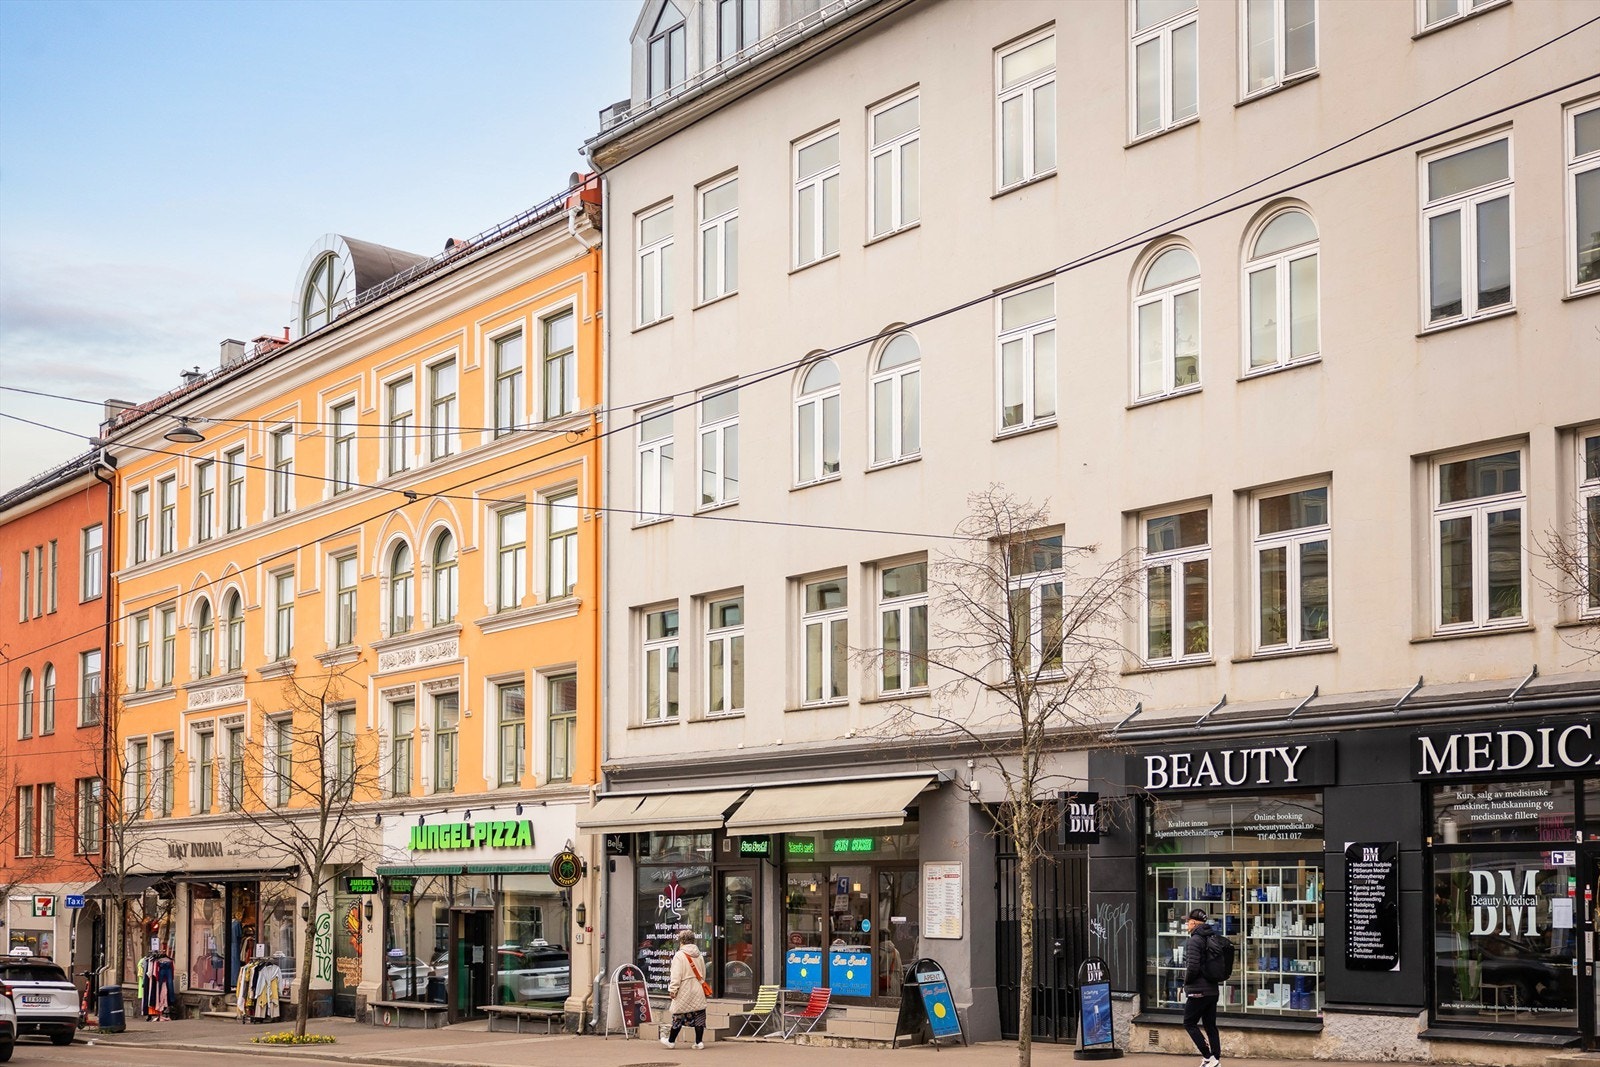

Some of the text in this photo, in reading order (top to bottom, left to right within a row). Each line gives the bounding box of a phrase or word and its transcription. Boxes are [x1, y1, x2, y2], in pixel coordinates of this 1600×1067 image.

[1418, 724, 1600, 775] MEDIC
[1144, 746, 1307, 790] BEAUTY
[1456, 791, 1476, 800] Kurs,
[1477, 791, 1493, 800] salg
[1505, 789, 1549, 798] medisinske
[1453, 801, 1554, 811] maskiner, hudskanning og
[1276, 812, 1303, 822] booking
[1470, 812, 1538, 821] medisinske fillere
[1243, 823, 1314, 833] www.beautymedical.no
[408, 820, 532, 850] JUNGEL PIZZA
[1257, 833, 1267, 841] Tlf
[191, 837, 223, 857] INDIANA
[67, 897, 84, 905] Taxi
[1471, 894, 1538, 908] Beauty Medical
[37, 898, 52, 916] 7
